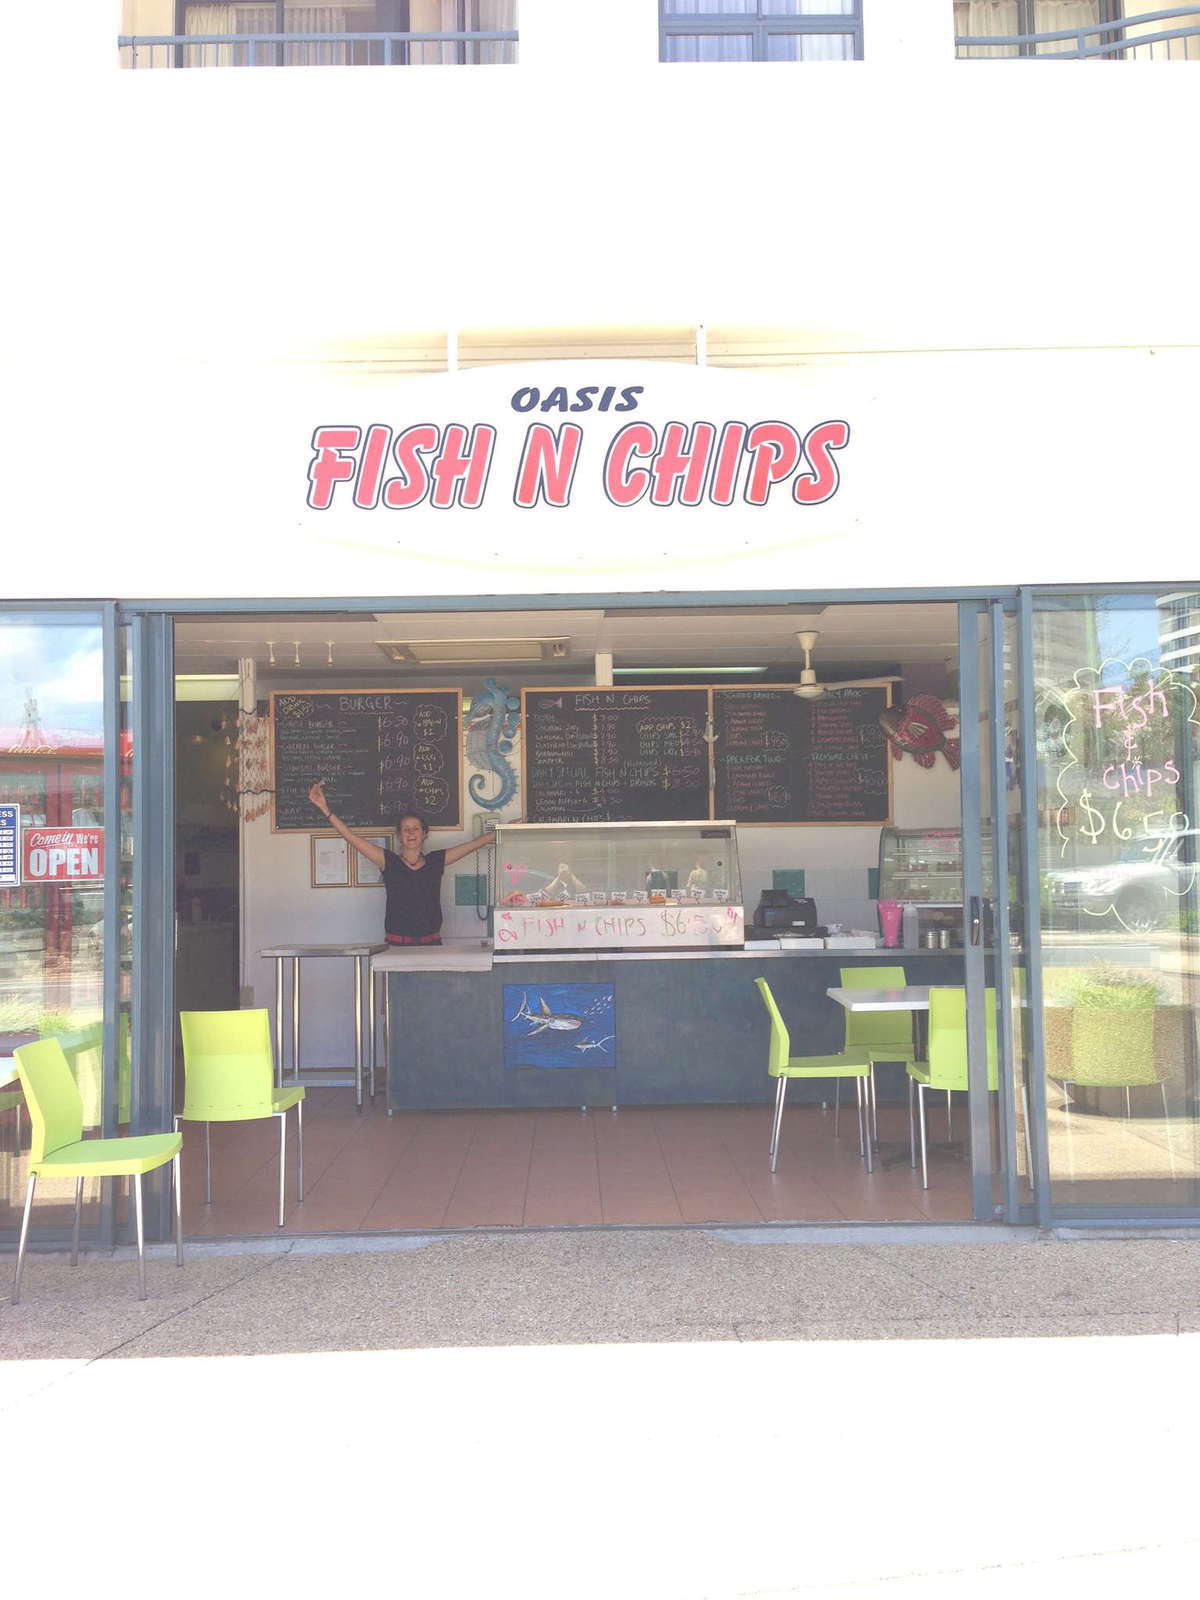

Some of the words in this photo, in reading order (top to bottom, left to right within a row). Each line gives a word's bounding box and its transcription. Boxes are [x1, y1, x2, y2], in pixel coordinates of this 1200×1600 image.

[510, 387, 643, 412] OASIS
[307, 423, 496, 510] FISH
[513, 422, 582, 508] N
[602, 420, 850, 507] CHIPS
[339, 696, 393, 711] BURGER
[575, 695, 601, 705] FISH
[606, 695, 616, 704] N
[623, 695, 652, 705] CHIPS
[29, 847, 99, 877] OPEN
[522, 917, 565, 938] FISH
[593, 915, 647, 937] CHIPS
